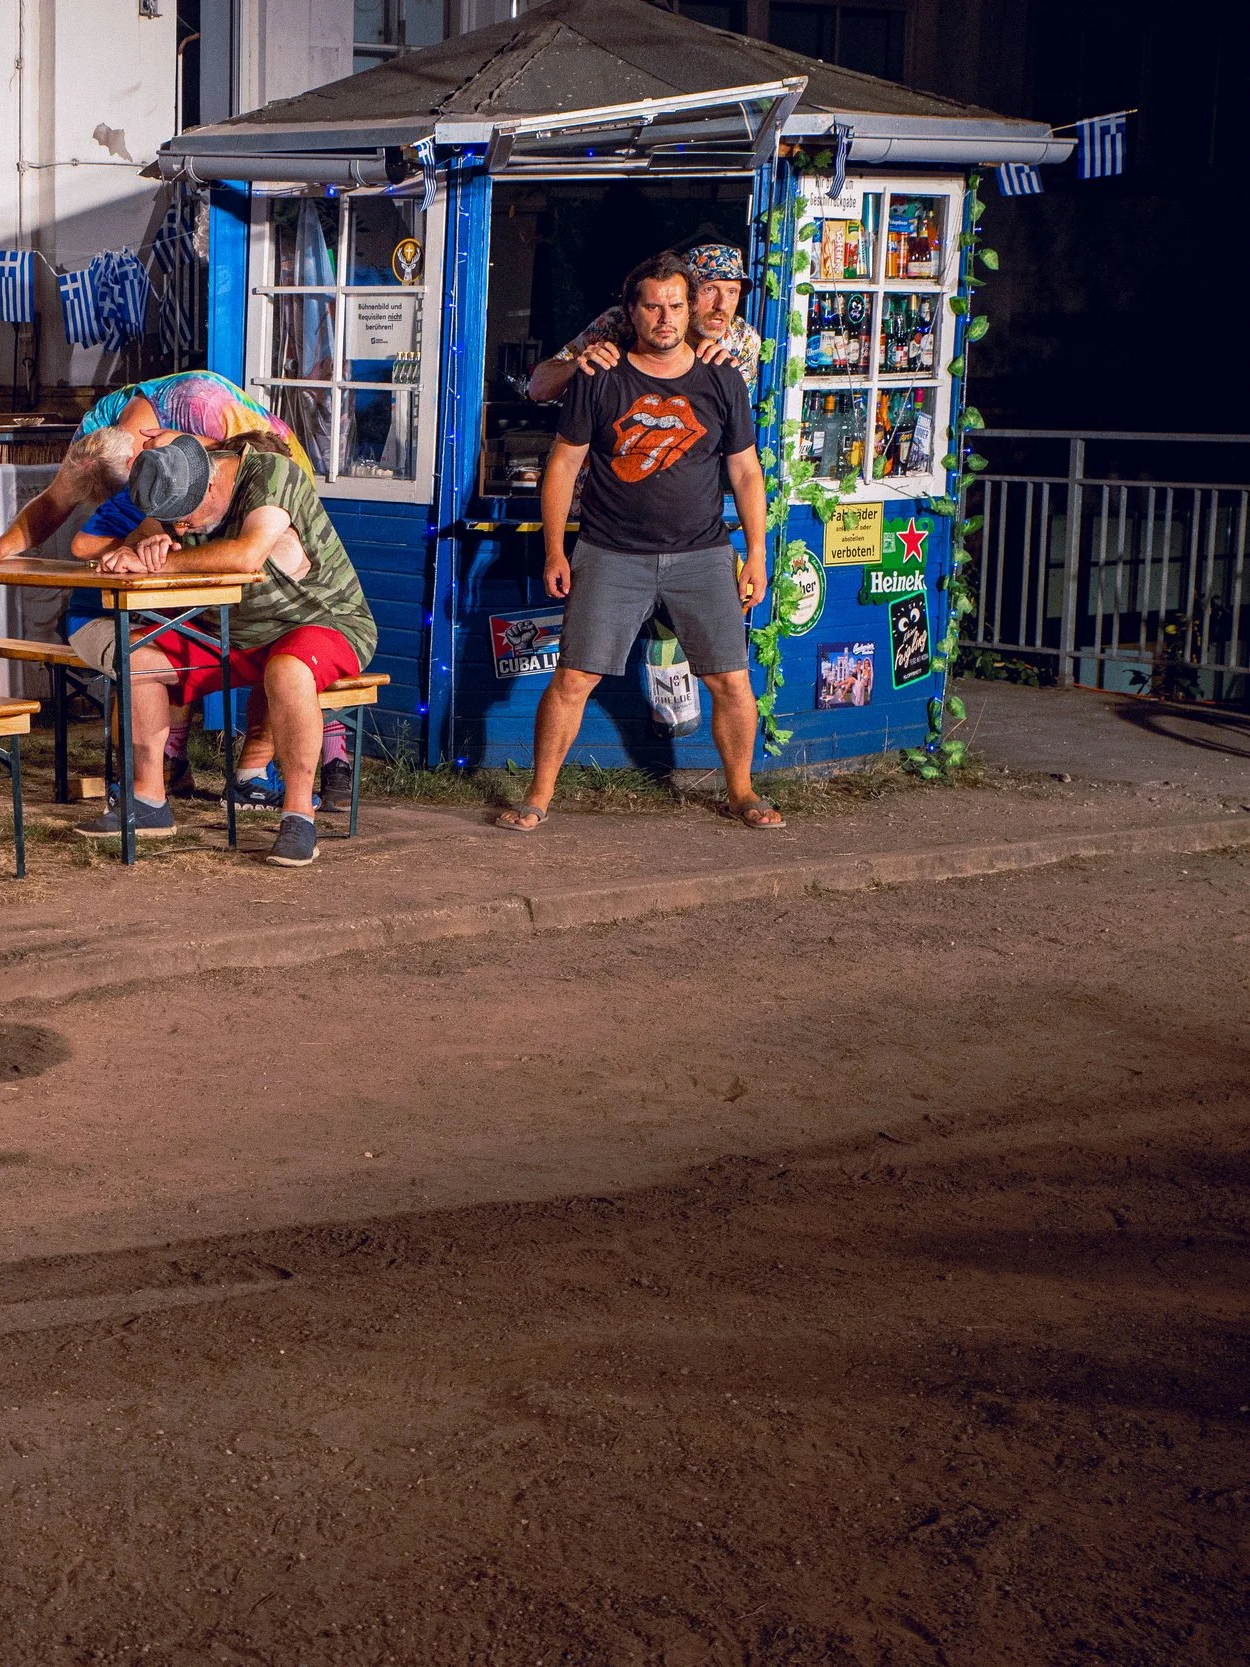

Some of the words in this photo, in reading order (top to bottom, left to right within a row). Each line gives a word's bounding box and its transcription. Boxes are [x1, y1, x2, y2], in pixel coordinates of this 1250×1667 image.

[358, 313, 387, 321] Requisiten
[387, 313, 403, 321] nicht
[831, 545, 875, 559] verboten!
[870, 570, 928, 593] Heinek
[499, 655, 541, 674] CUBA
[543, 652, 561, 669] LI
